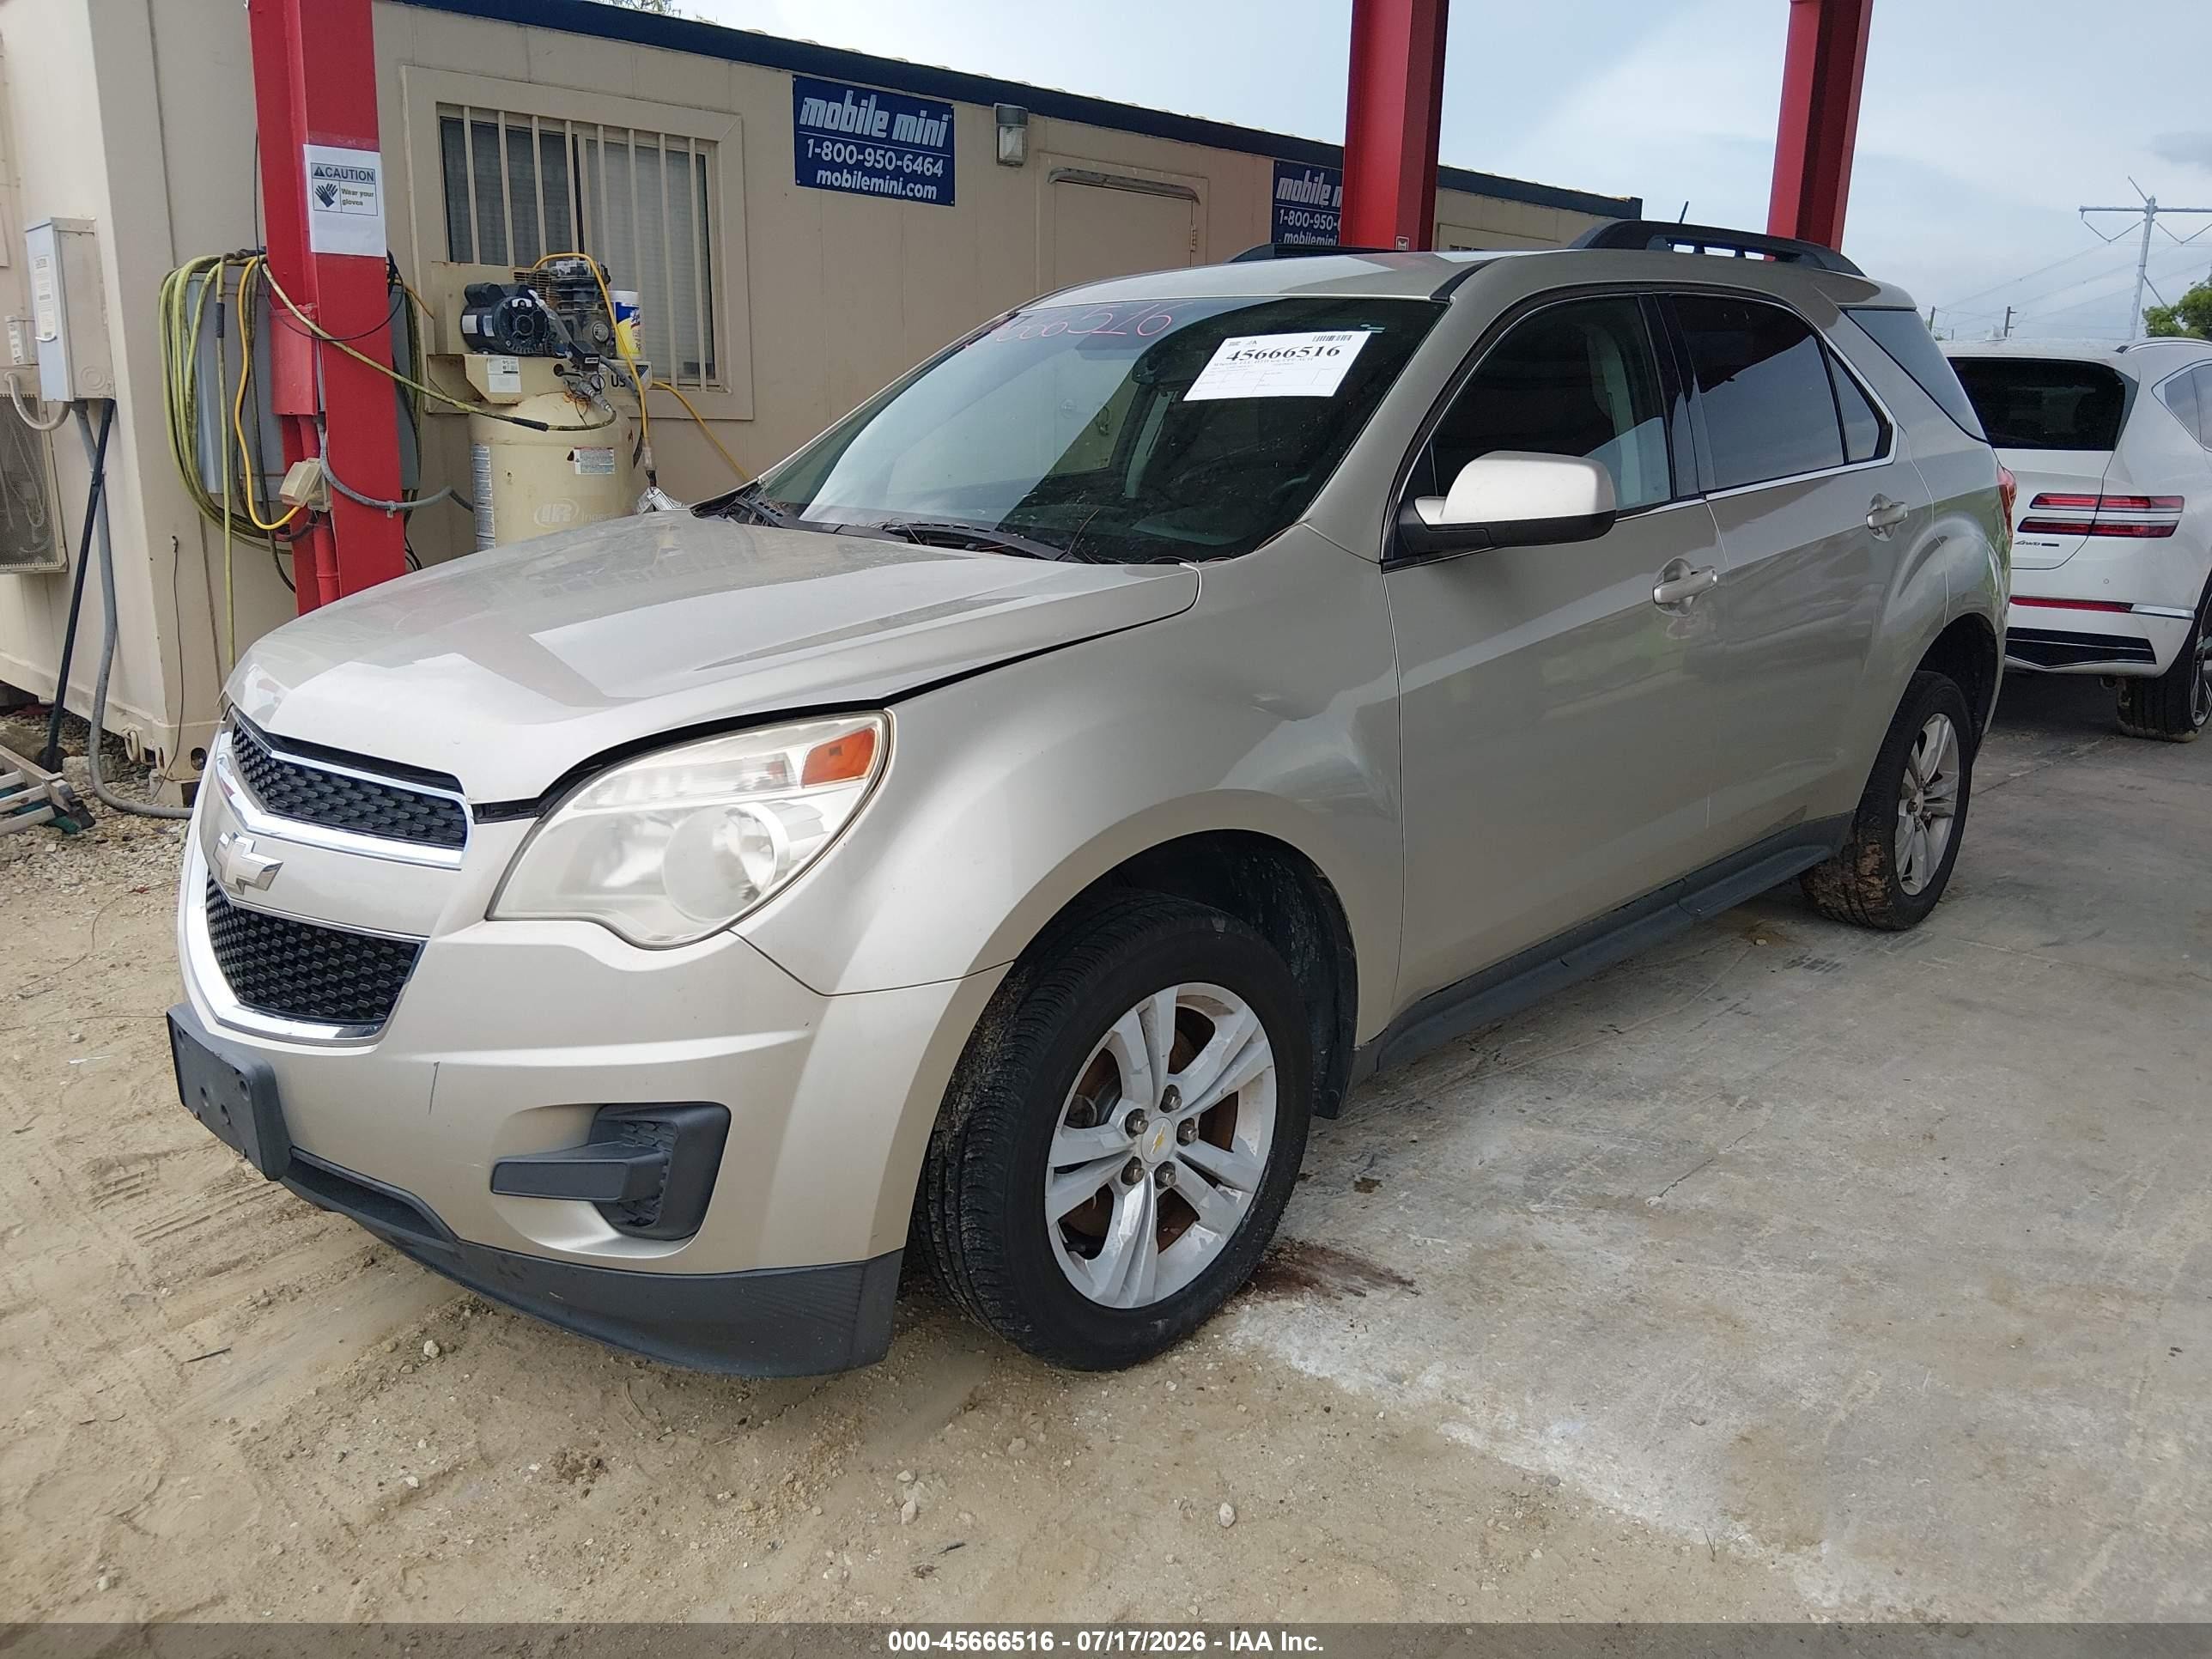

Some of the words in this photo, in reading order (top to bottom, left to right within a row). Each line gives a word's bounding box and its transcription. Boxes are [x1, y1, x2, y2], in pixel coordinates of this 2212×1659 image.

[799, 89, 890, 138] mobile
[891, 110, 949, 148] mini
[807, 138, 944, 178] 1-800-950-6464
[325, 167, 374, 181] CAUTION
[817, 169, 937, 199] mobilemini.com
[1276, 170, 1331, 206] mobile
[1226, 345, 1346, 362] 45666516
[611, 374, 634, 388] US
